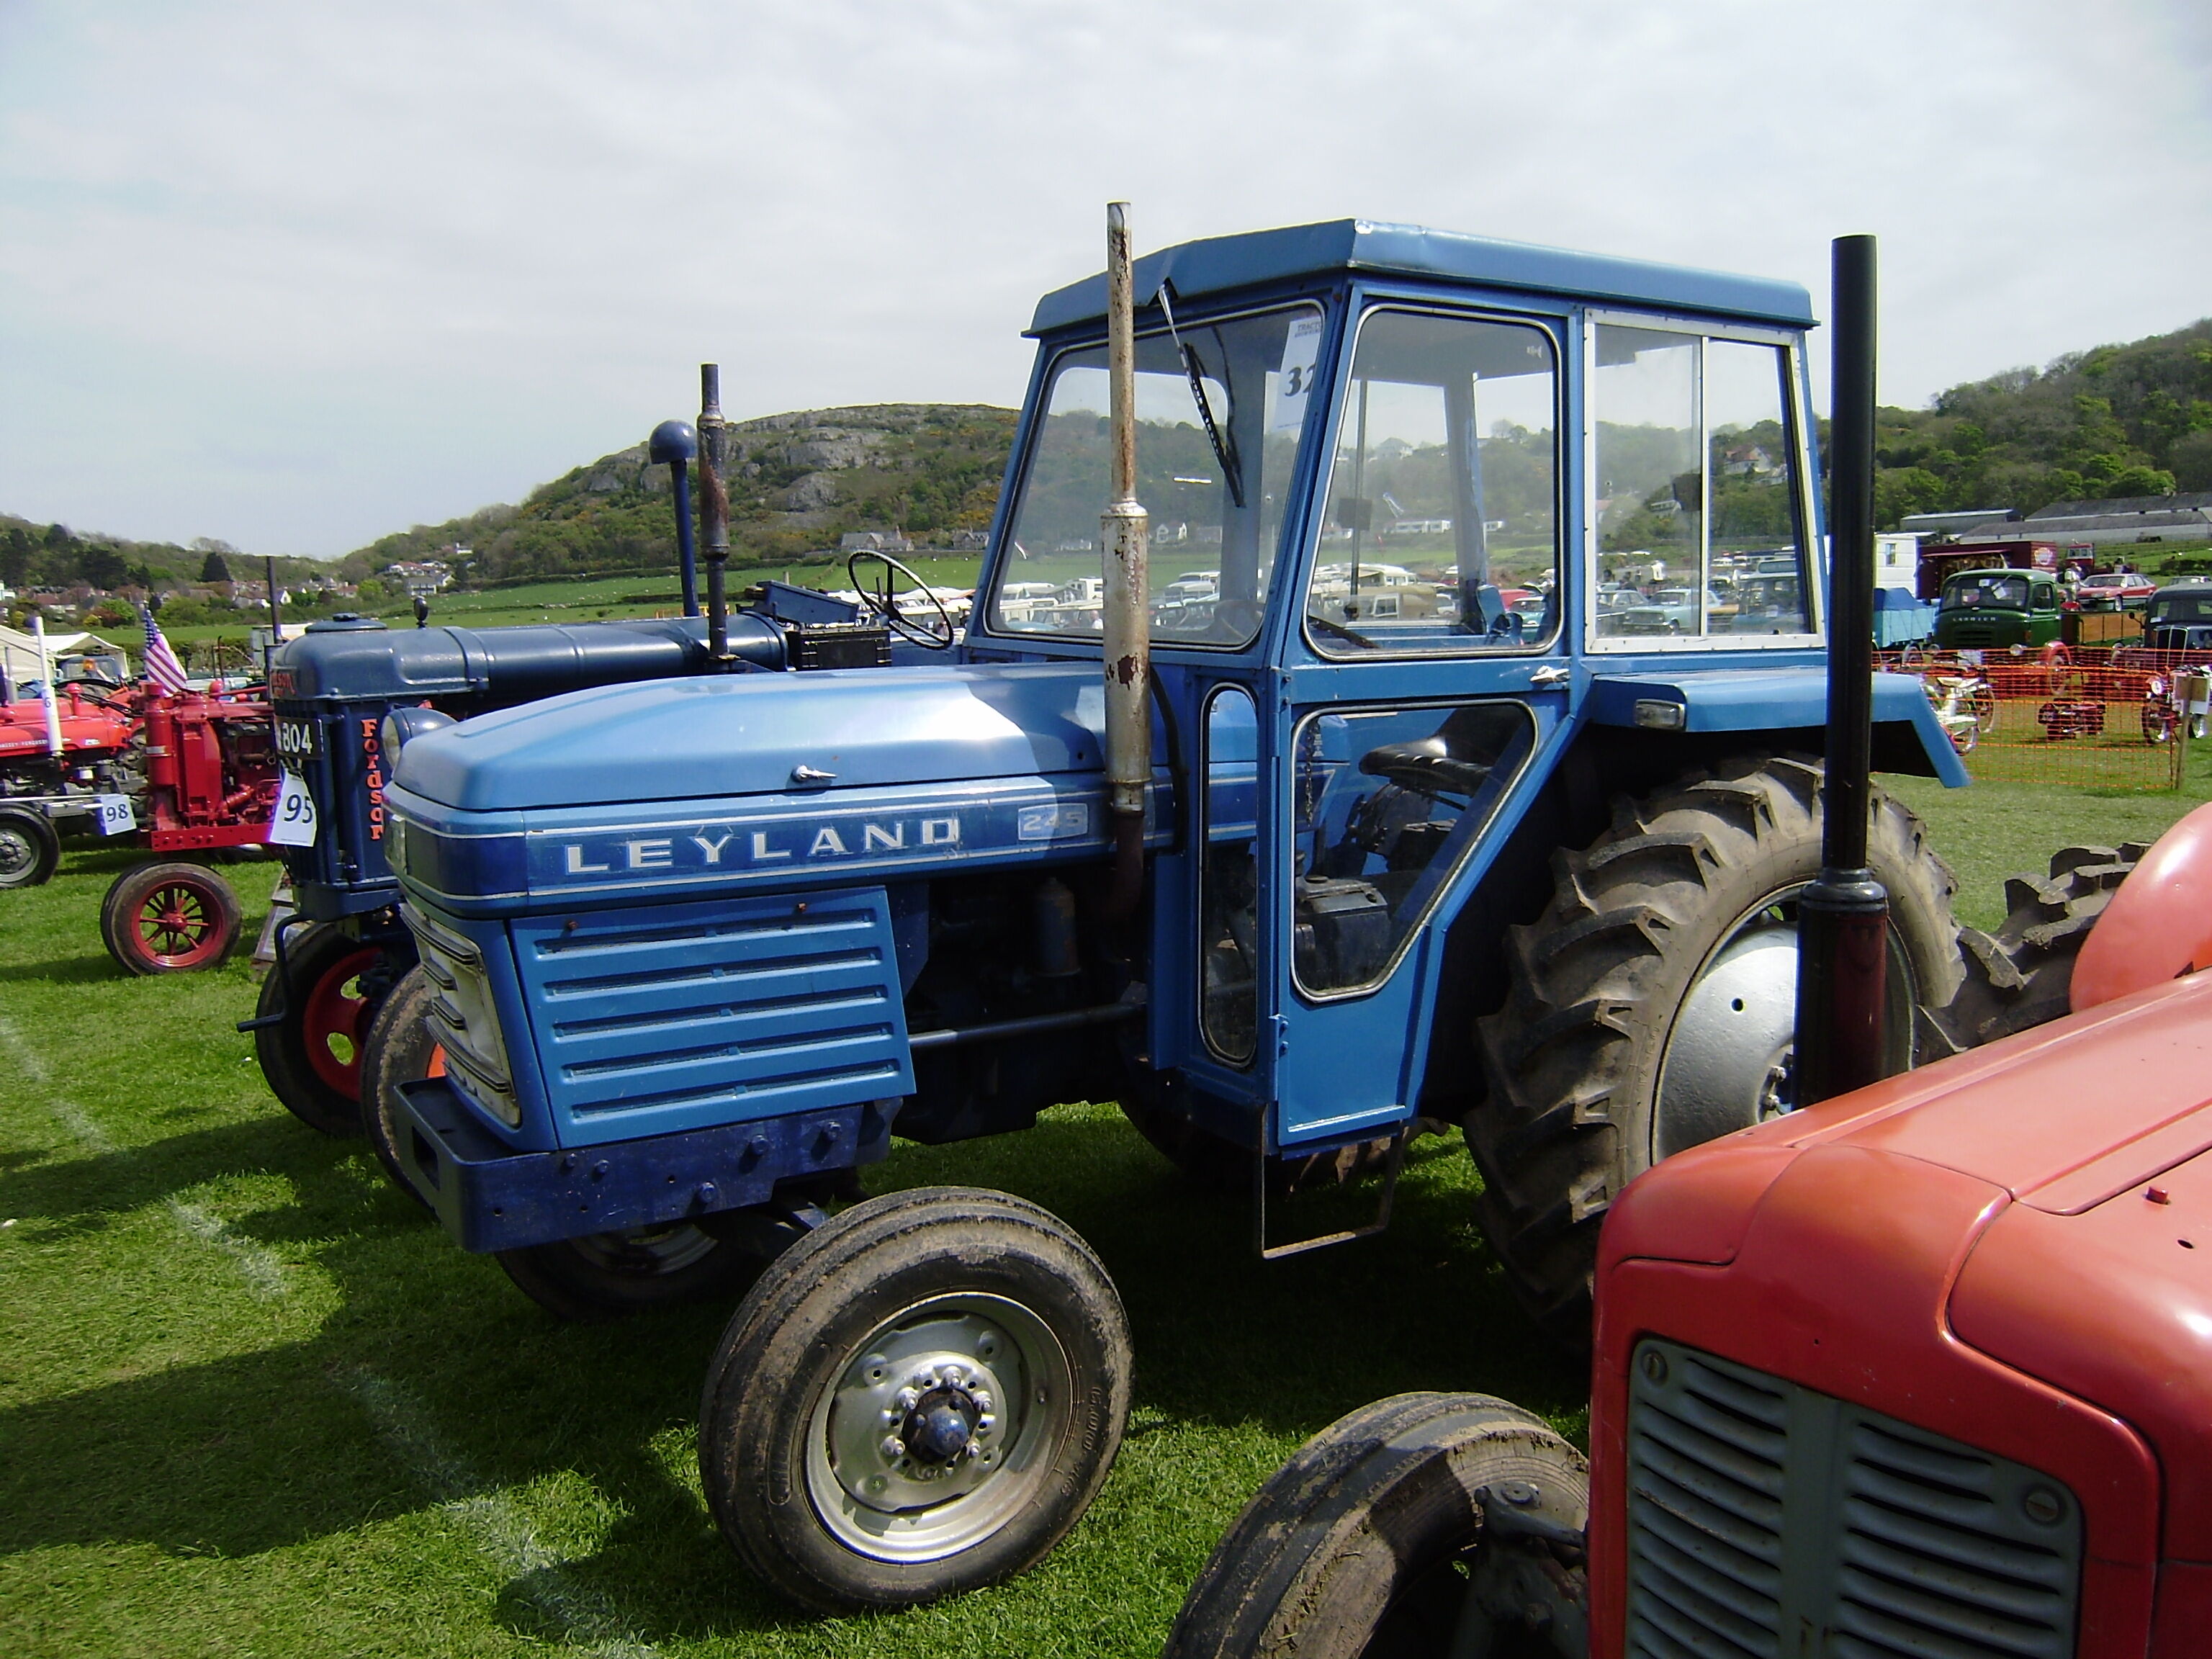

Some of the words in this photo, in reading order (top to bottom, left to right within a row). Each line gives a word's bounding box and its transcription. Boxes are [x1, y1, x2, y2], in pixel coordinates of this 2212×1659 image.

[107, 804, 128, 822] 98
[284, 794, 313, 824] 95
[567, 818, 961, 873] LEYLAND
[1023, 812, 1082, 831] 245
